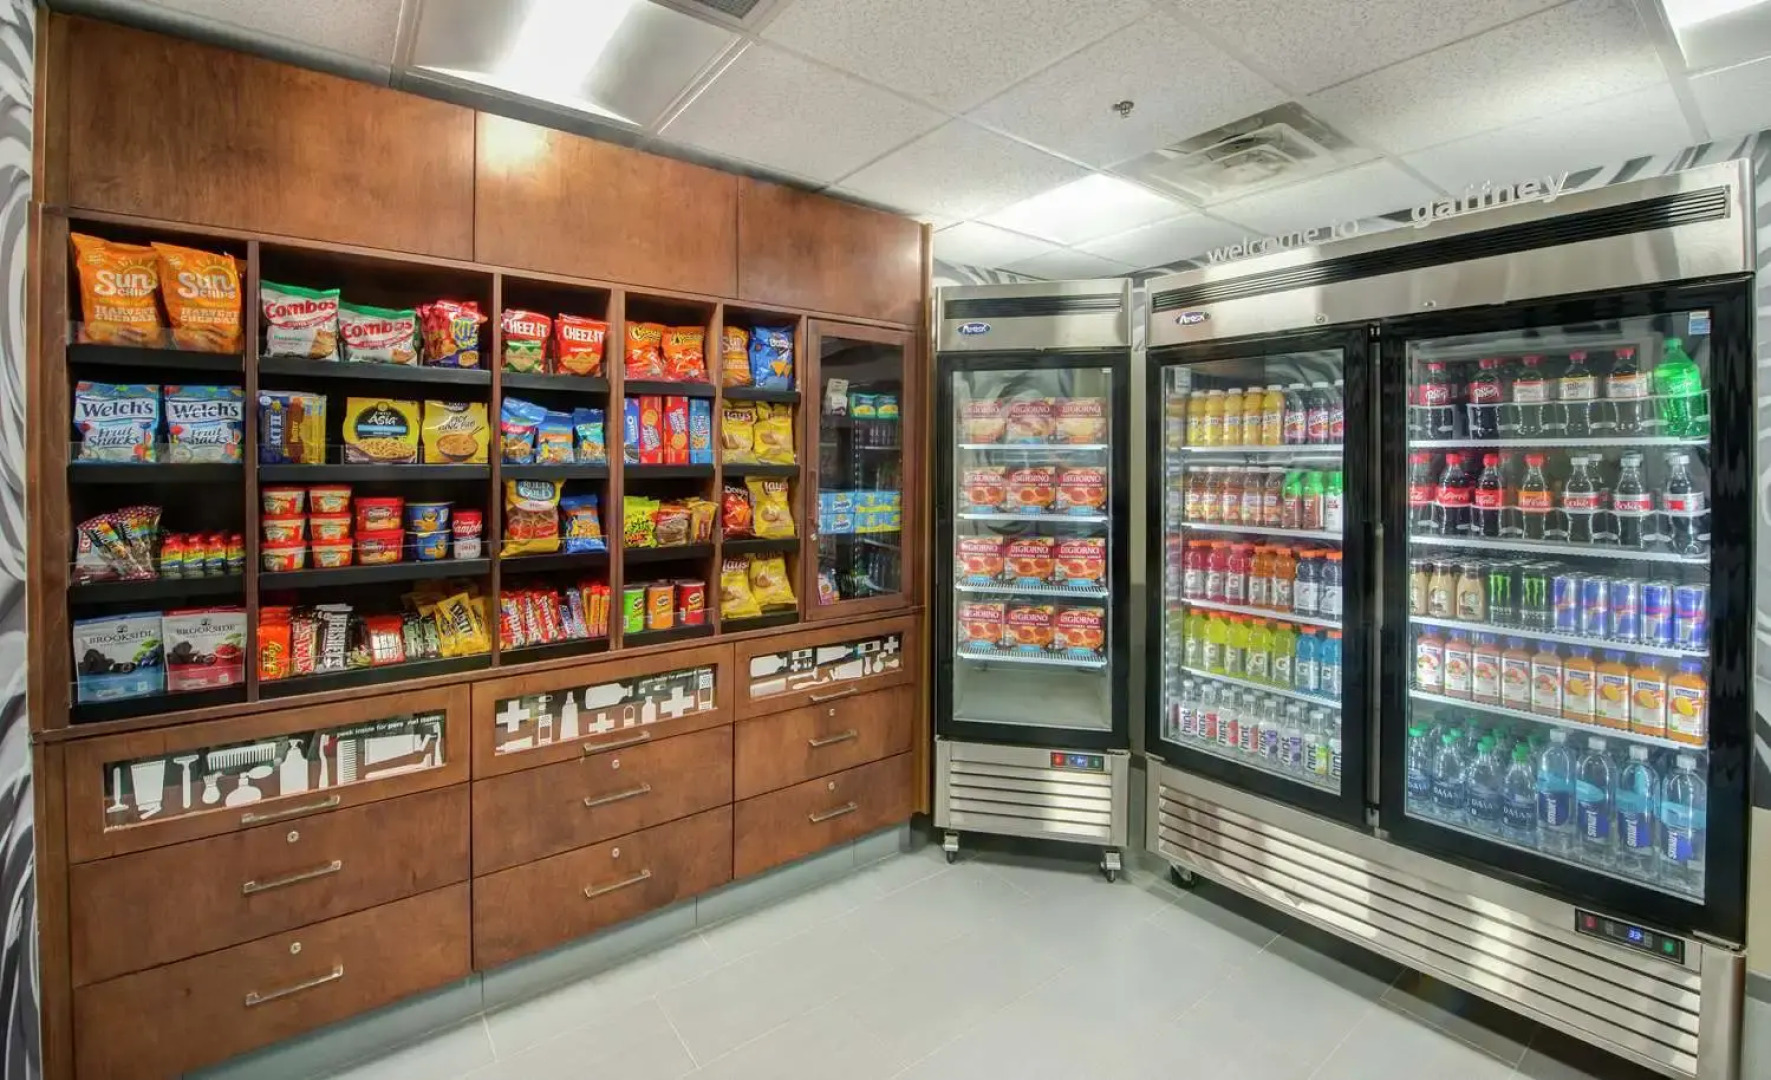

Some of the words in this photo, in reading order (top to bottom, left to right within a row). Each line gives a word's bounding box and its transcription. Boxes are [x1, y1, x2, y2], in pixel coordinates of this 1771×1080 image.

[1207, 226, 1319, 263] welcome
[1330, 218, 1360, 238] to
[1411, 169, 1568, 228] gaffney
[94, 270, 156, 296] Sun
[178, 272, 235, 298] Sun
[265, 300, 337, 319] Combos
[341, 320, 413, 338] Combos
[563, 325, 604, 342] CHEEZ-IT
[81, 401, 153, 417] Welch's
[172, 402, 239, 418] Welch's
[368, 415, 398, 425] Asia
[99, 426, 132, 436] Fruit
[192, 427, 222, 436] Fruit
[89, 435, 140, 446] Snacks
[184, 436, 228, 445] Snacks
